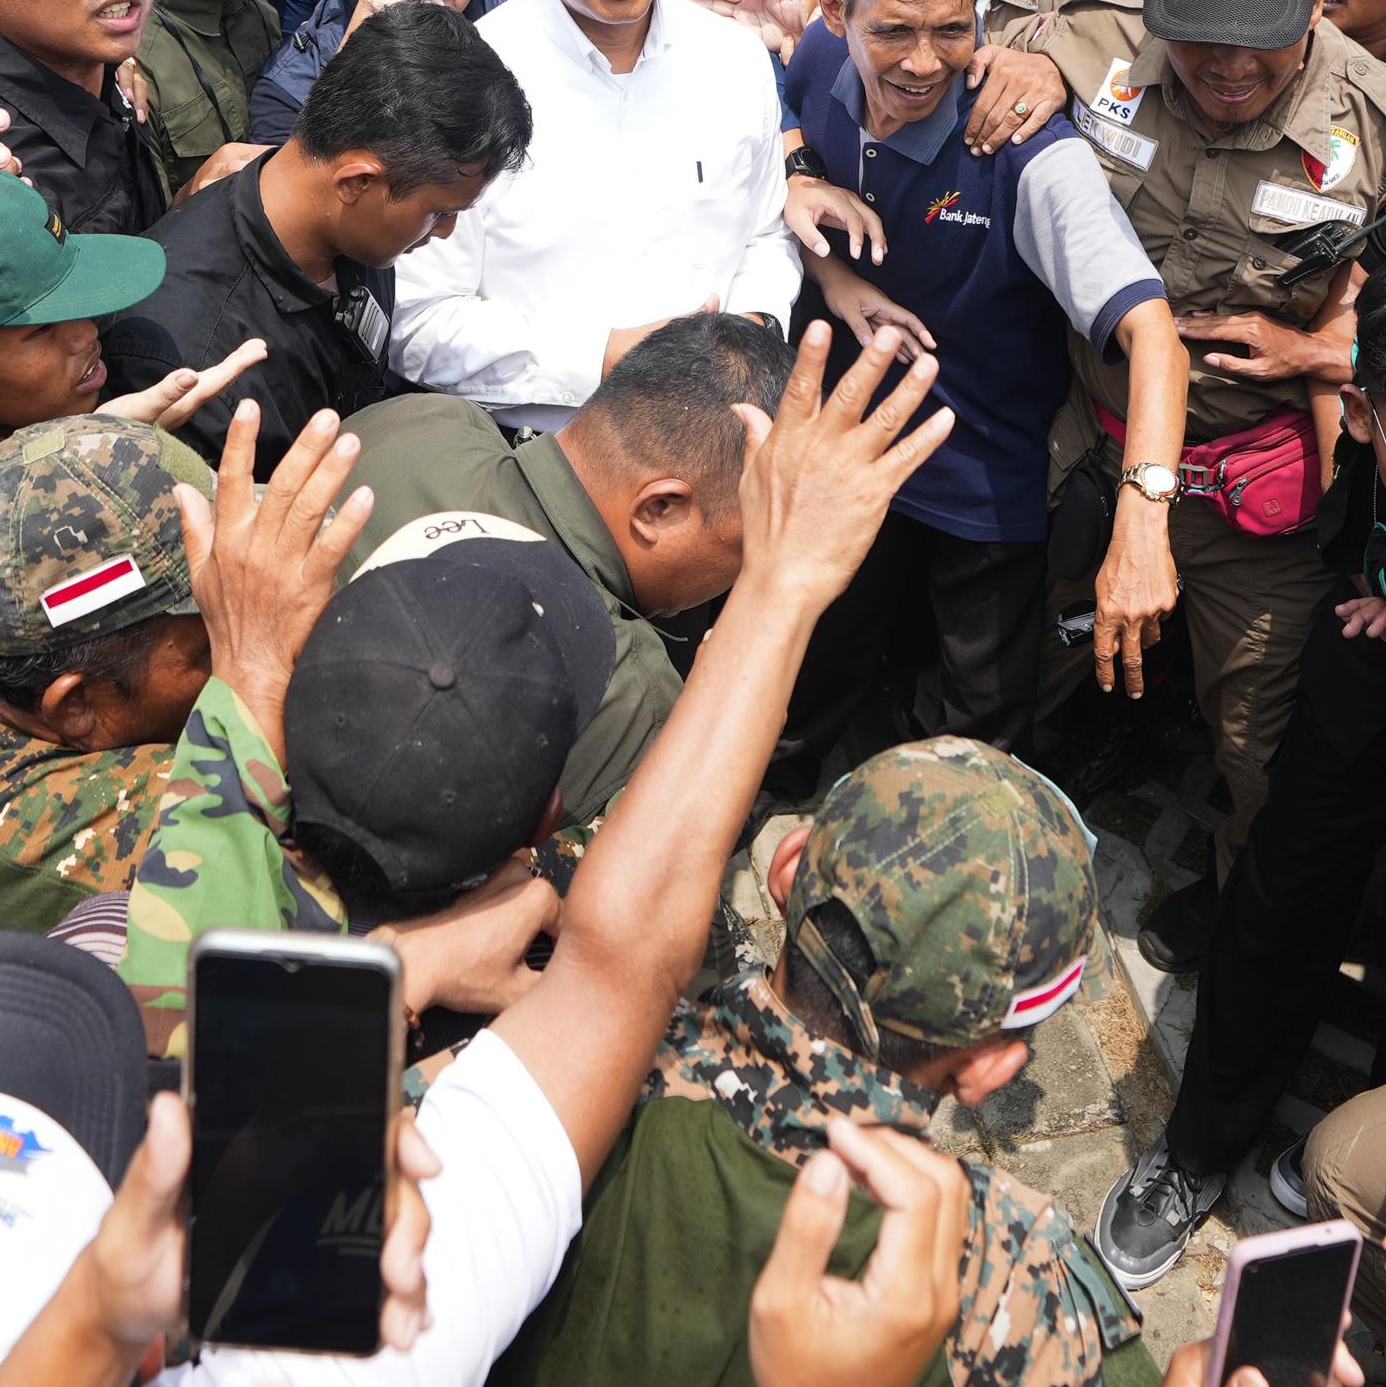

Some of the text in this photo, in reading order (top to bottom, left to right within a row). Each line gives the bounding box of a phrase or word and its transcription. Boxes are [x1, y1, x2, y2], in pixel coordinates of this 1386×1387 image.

[1097, 99, 1130, 121] PKS
[1102, 126, 1141, 158] WIDI
[939, 208, 991, 229] Bank Jateng
